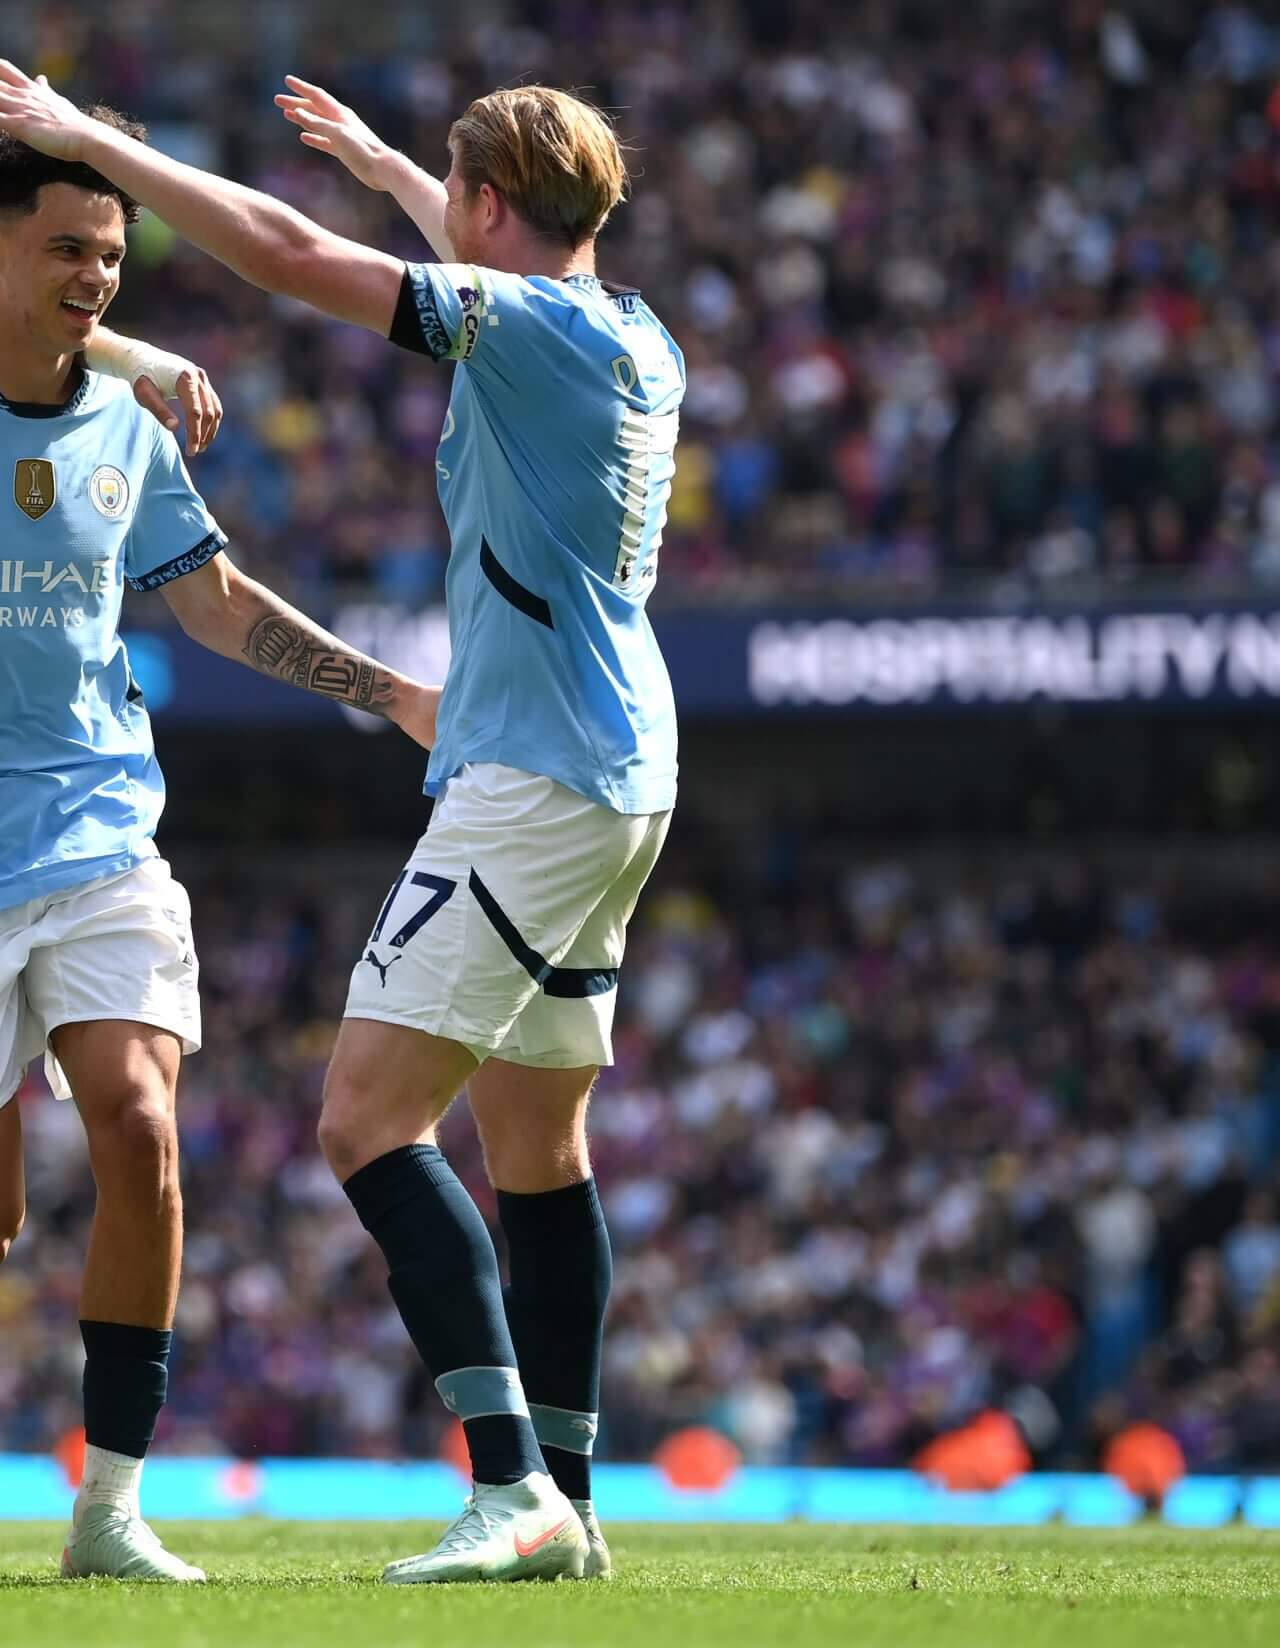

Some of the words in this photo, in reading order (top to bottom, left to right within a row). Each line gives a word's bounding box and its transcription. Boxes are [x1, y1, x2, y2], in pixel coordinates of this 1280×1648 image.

[26, 496, 44, 505] FIFA
[749, 614, 1223, 704] HOSPITALITY
[370, 868, 458, 949] 17
